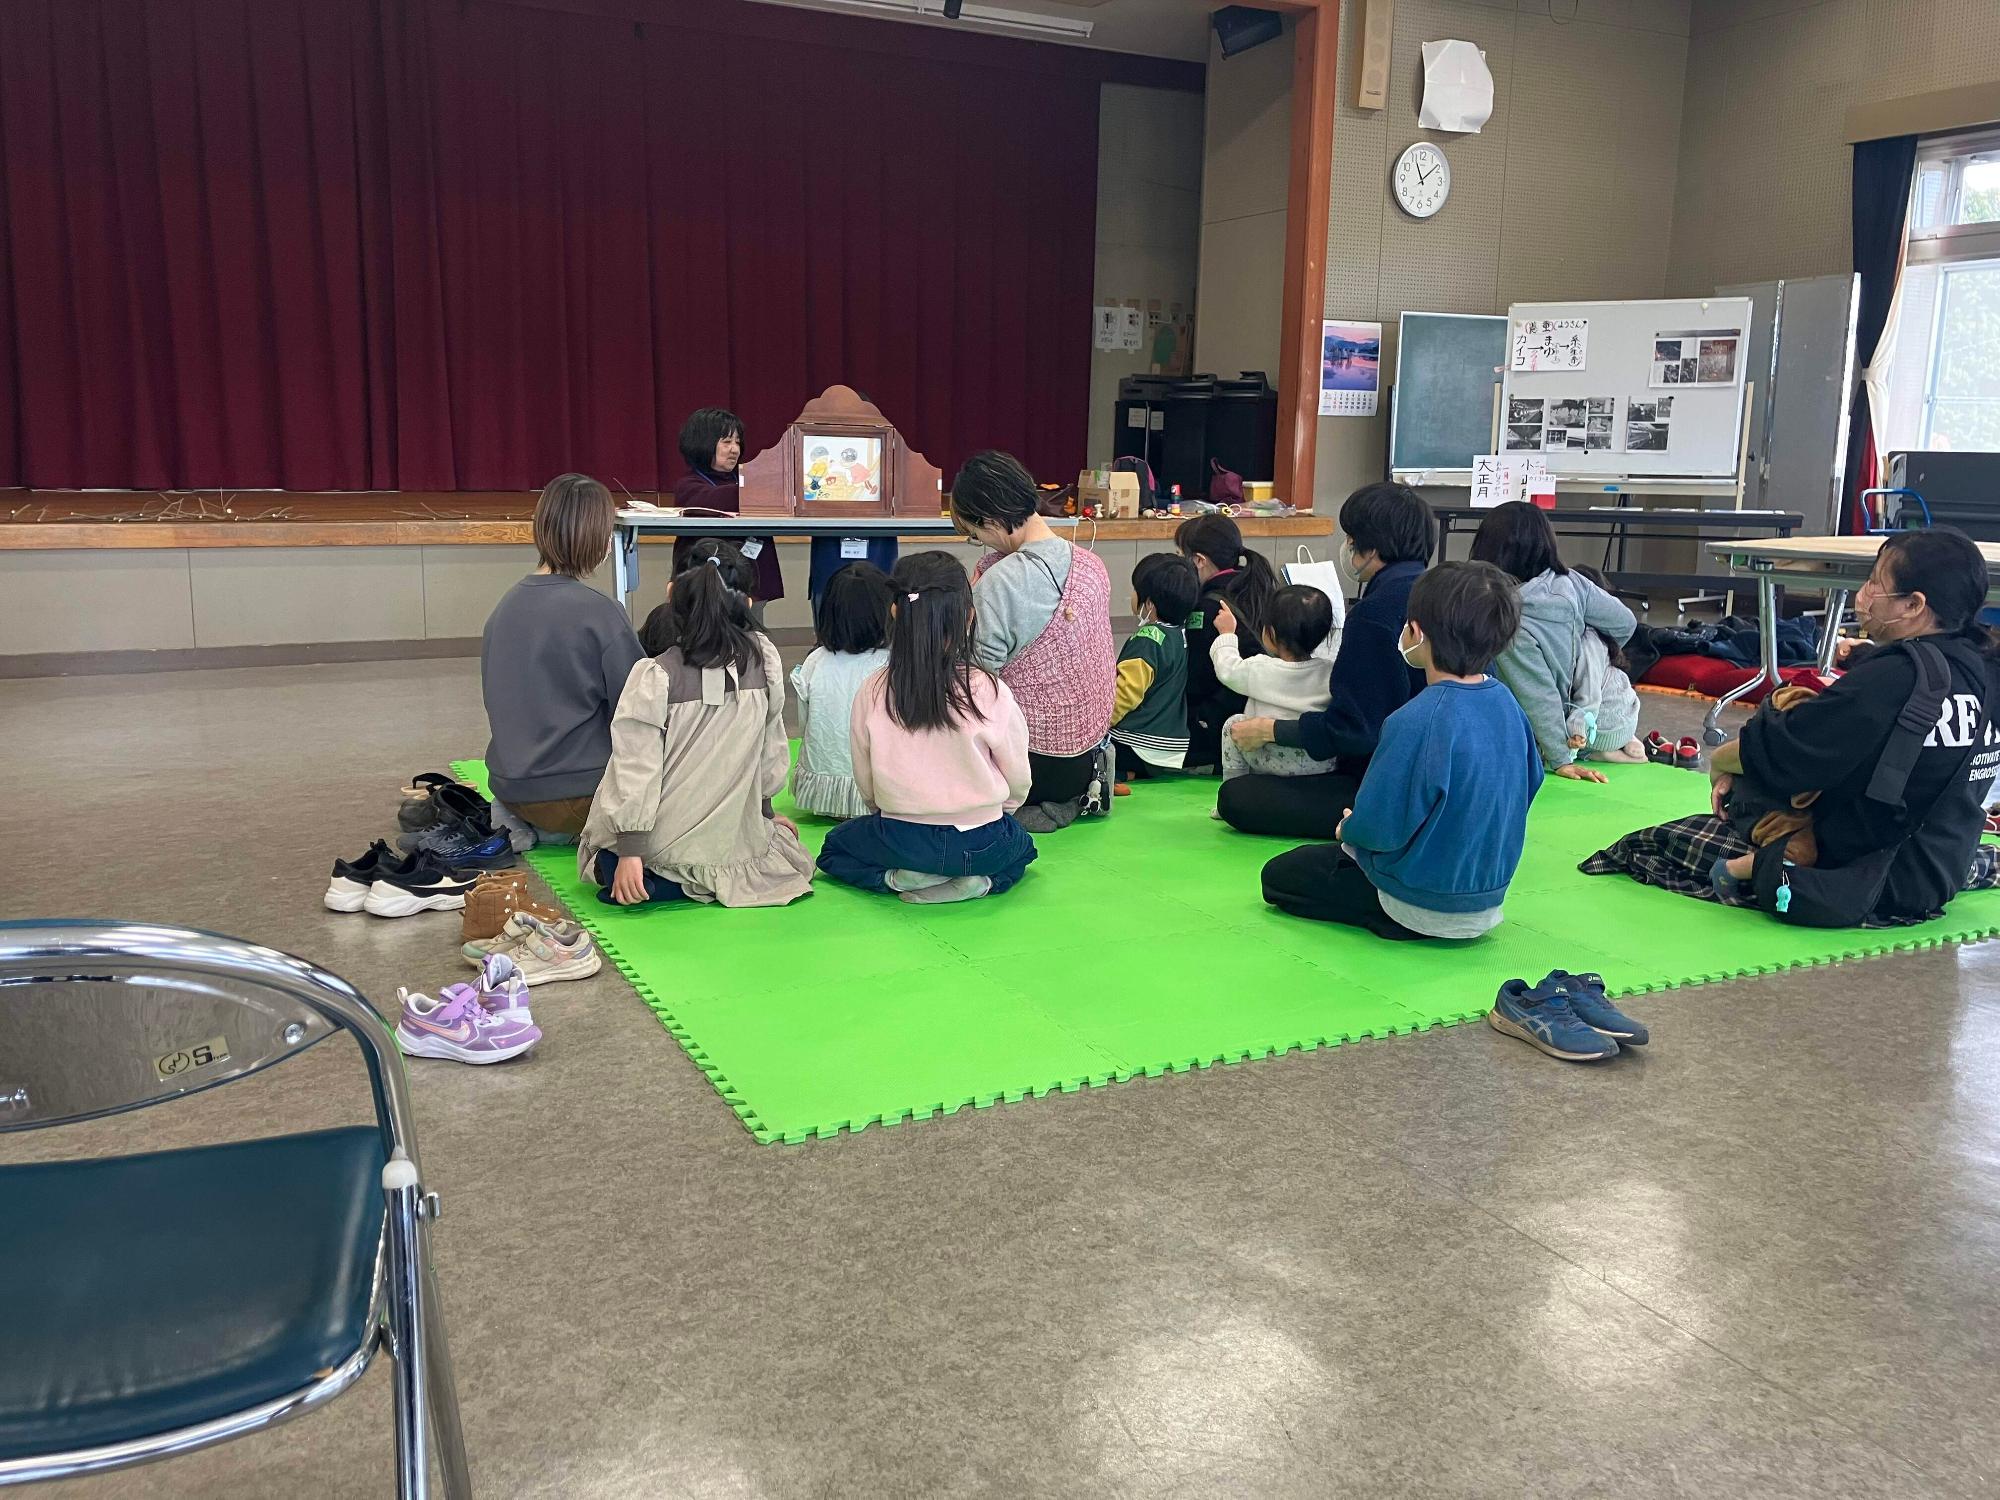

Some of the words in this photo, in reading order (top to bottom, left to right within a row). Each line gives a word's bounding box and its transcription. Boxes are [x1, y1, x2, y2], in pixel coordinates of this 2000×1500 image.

[1420, 151, 1427, 161] 12
[1404, 162, 1411, 172] 10
[1400, 174, 1406, 183] 9
[1438, 177, 1443, 186] 3
[1402, 187, 1408, 197] 8
[1434, 190, 1439, 200] 4
[1409, 196, 1415, 205] 7
[1417, 200, 1423, 209] 6
[1426, 197, 1432, 207] 5
[1515, 335, 1527, 366] カイコ
[1543, 335, 1555, 358] まゆ
[1477, 459, 1494, 499] 大正月
[193, 1045, 213, 1067] S
